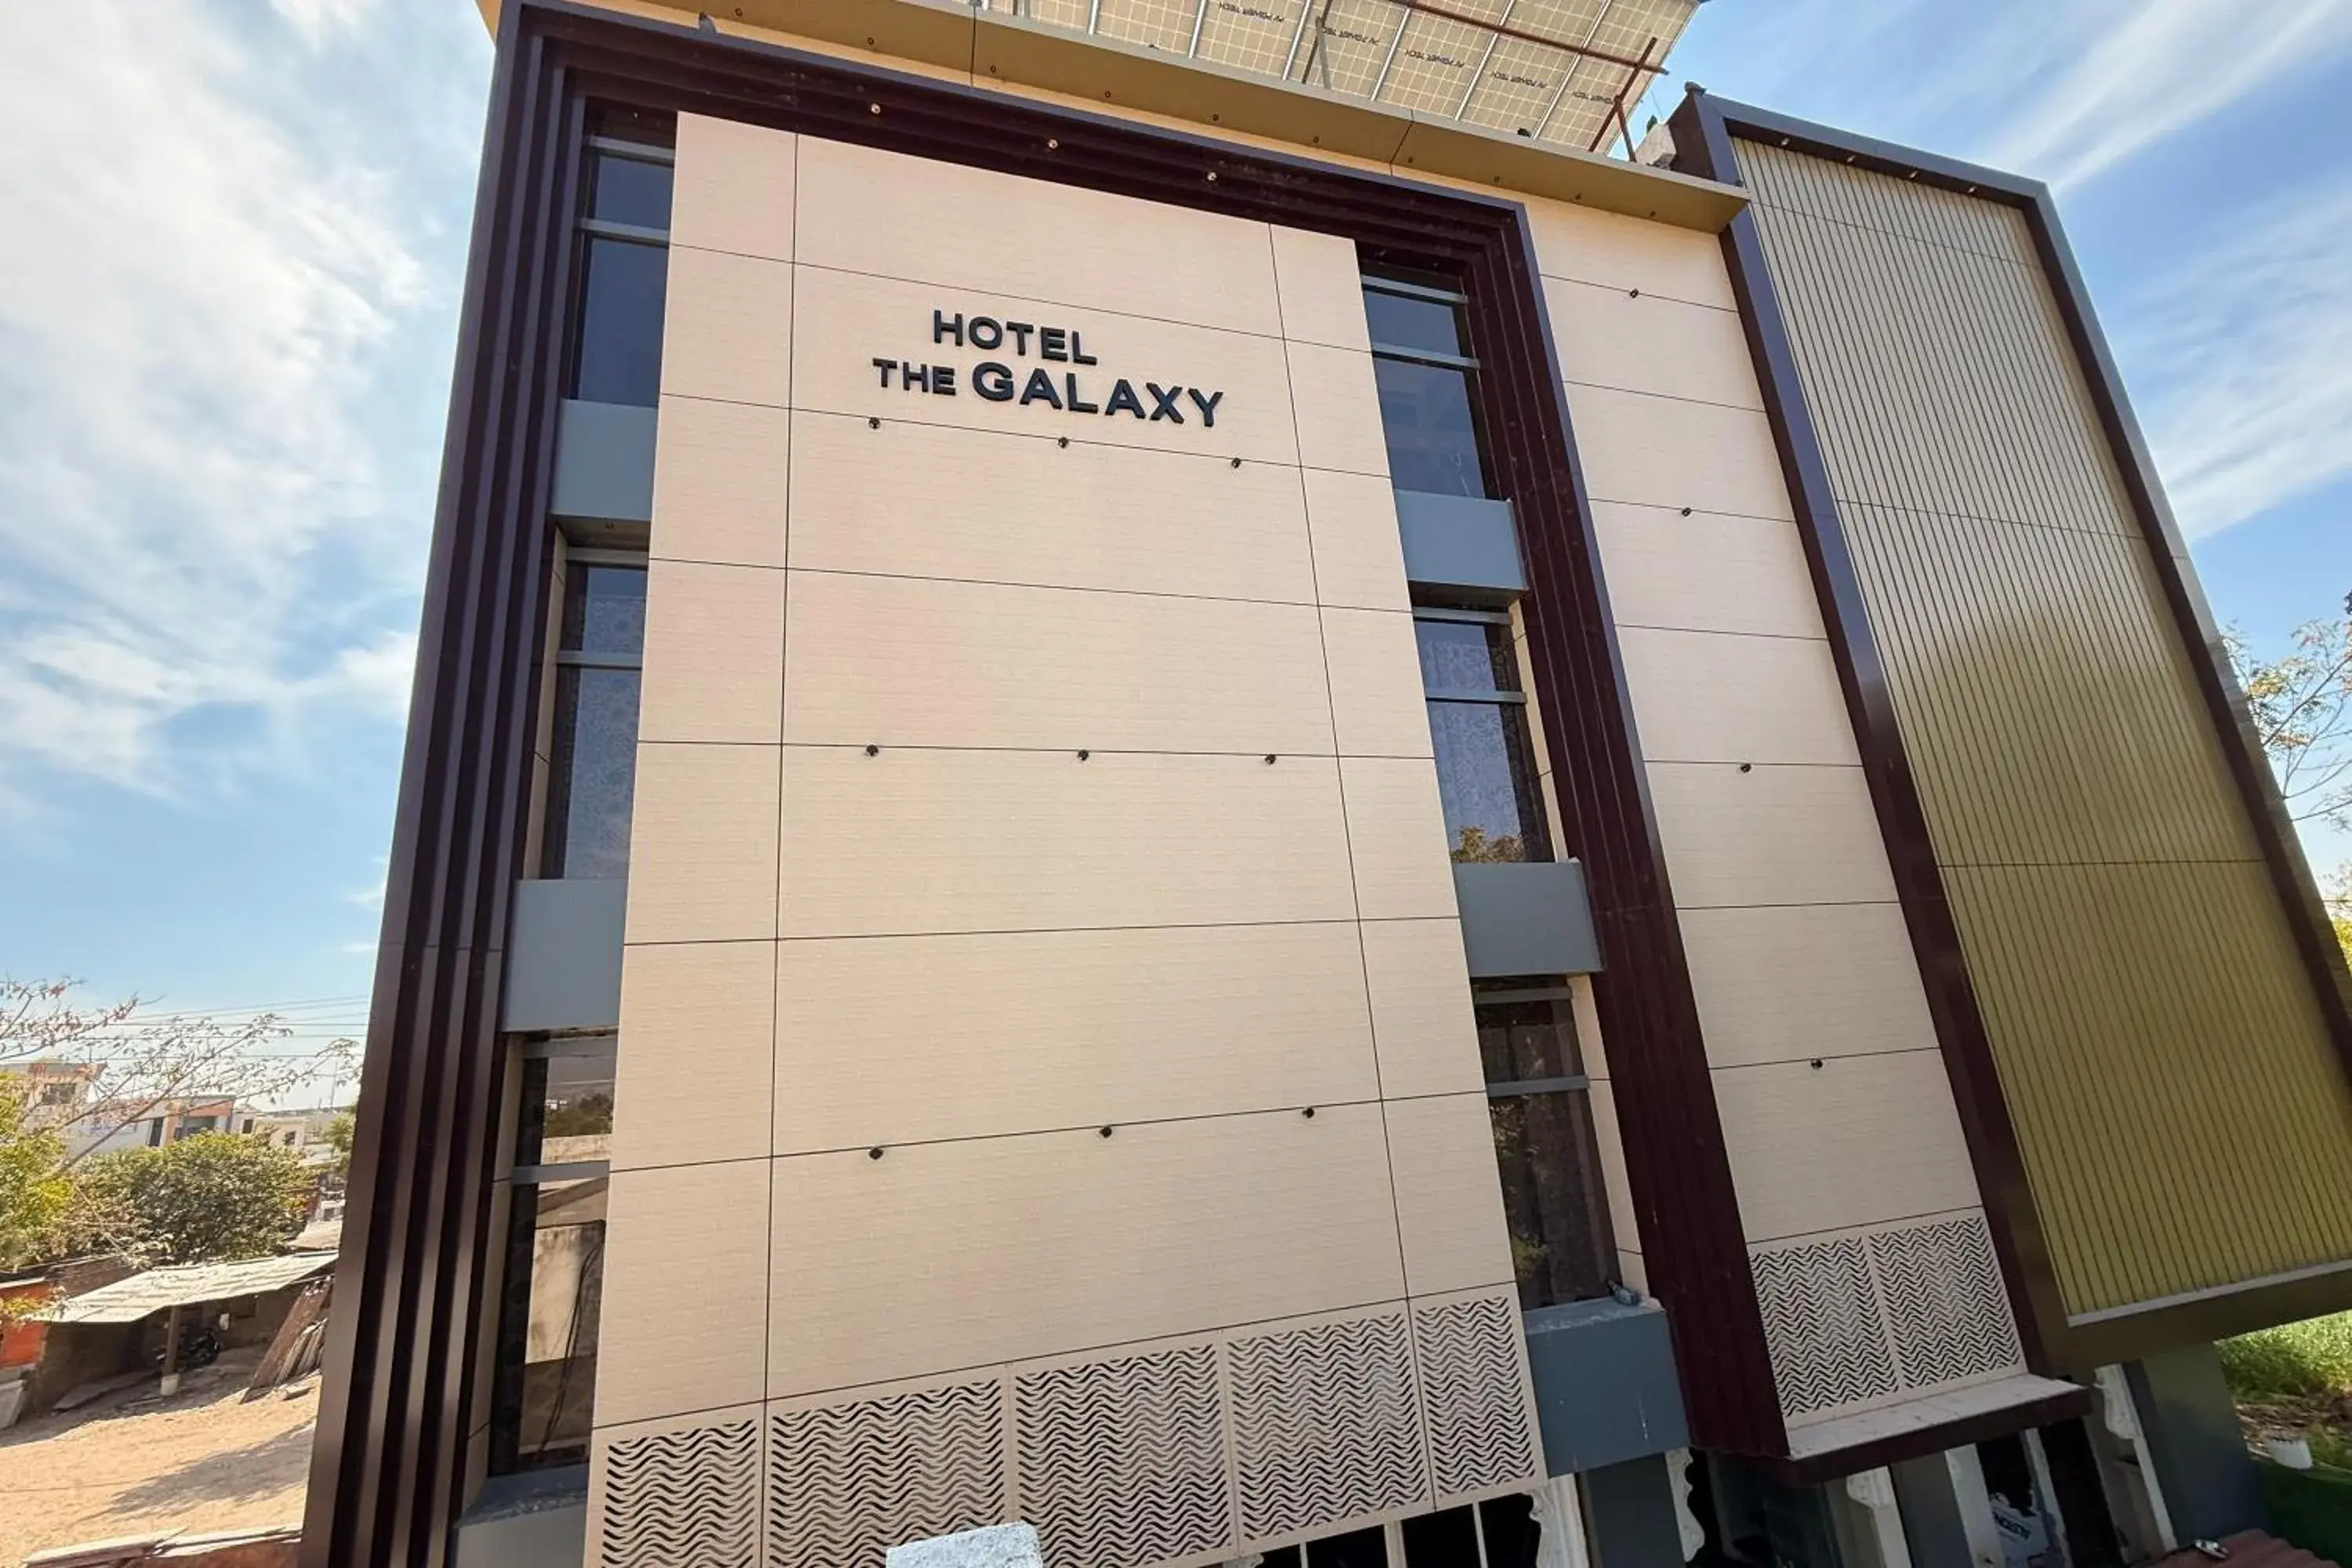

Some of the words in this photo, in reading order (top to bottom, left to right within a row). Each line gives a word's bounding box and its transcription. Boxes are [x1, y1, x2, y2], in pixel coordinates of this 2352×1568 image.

[933, 310, 1098, 366] HOTEL
[872, 357, 957, 396] THE
[971, 361, 1224, 427] GALAXY
